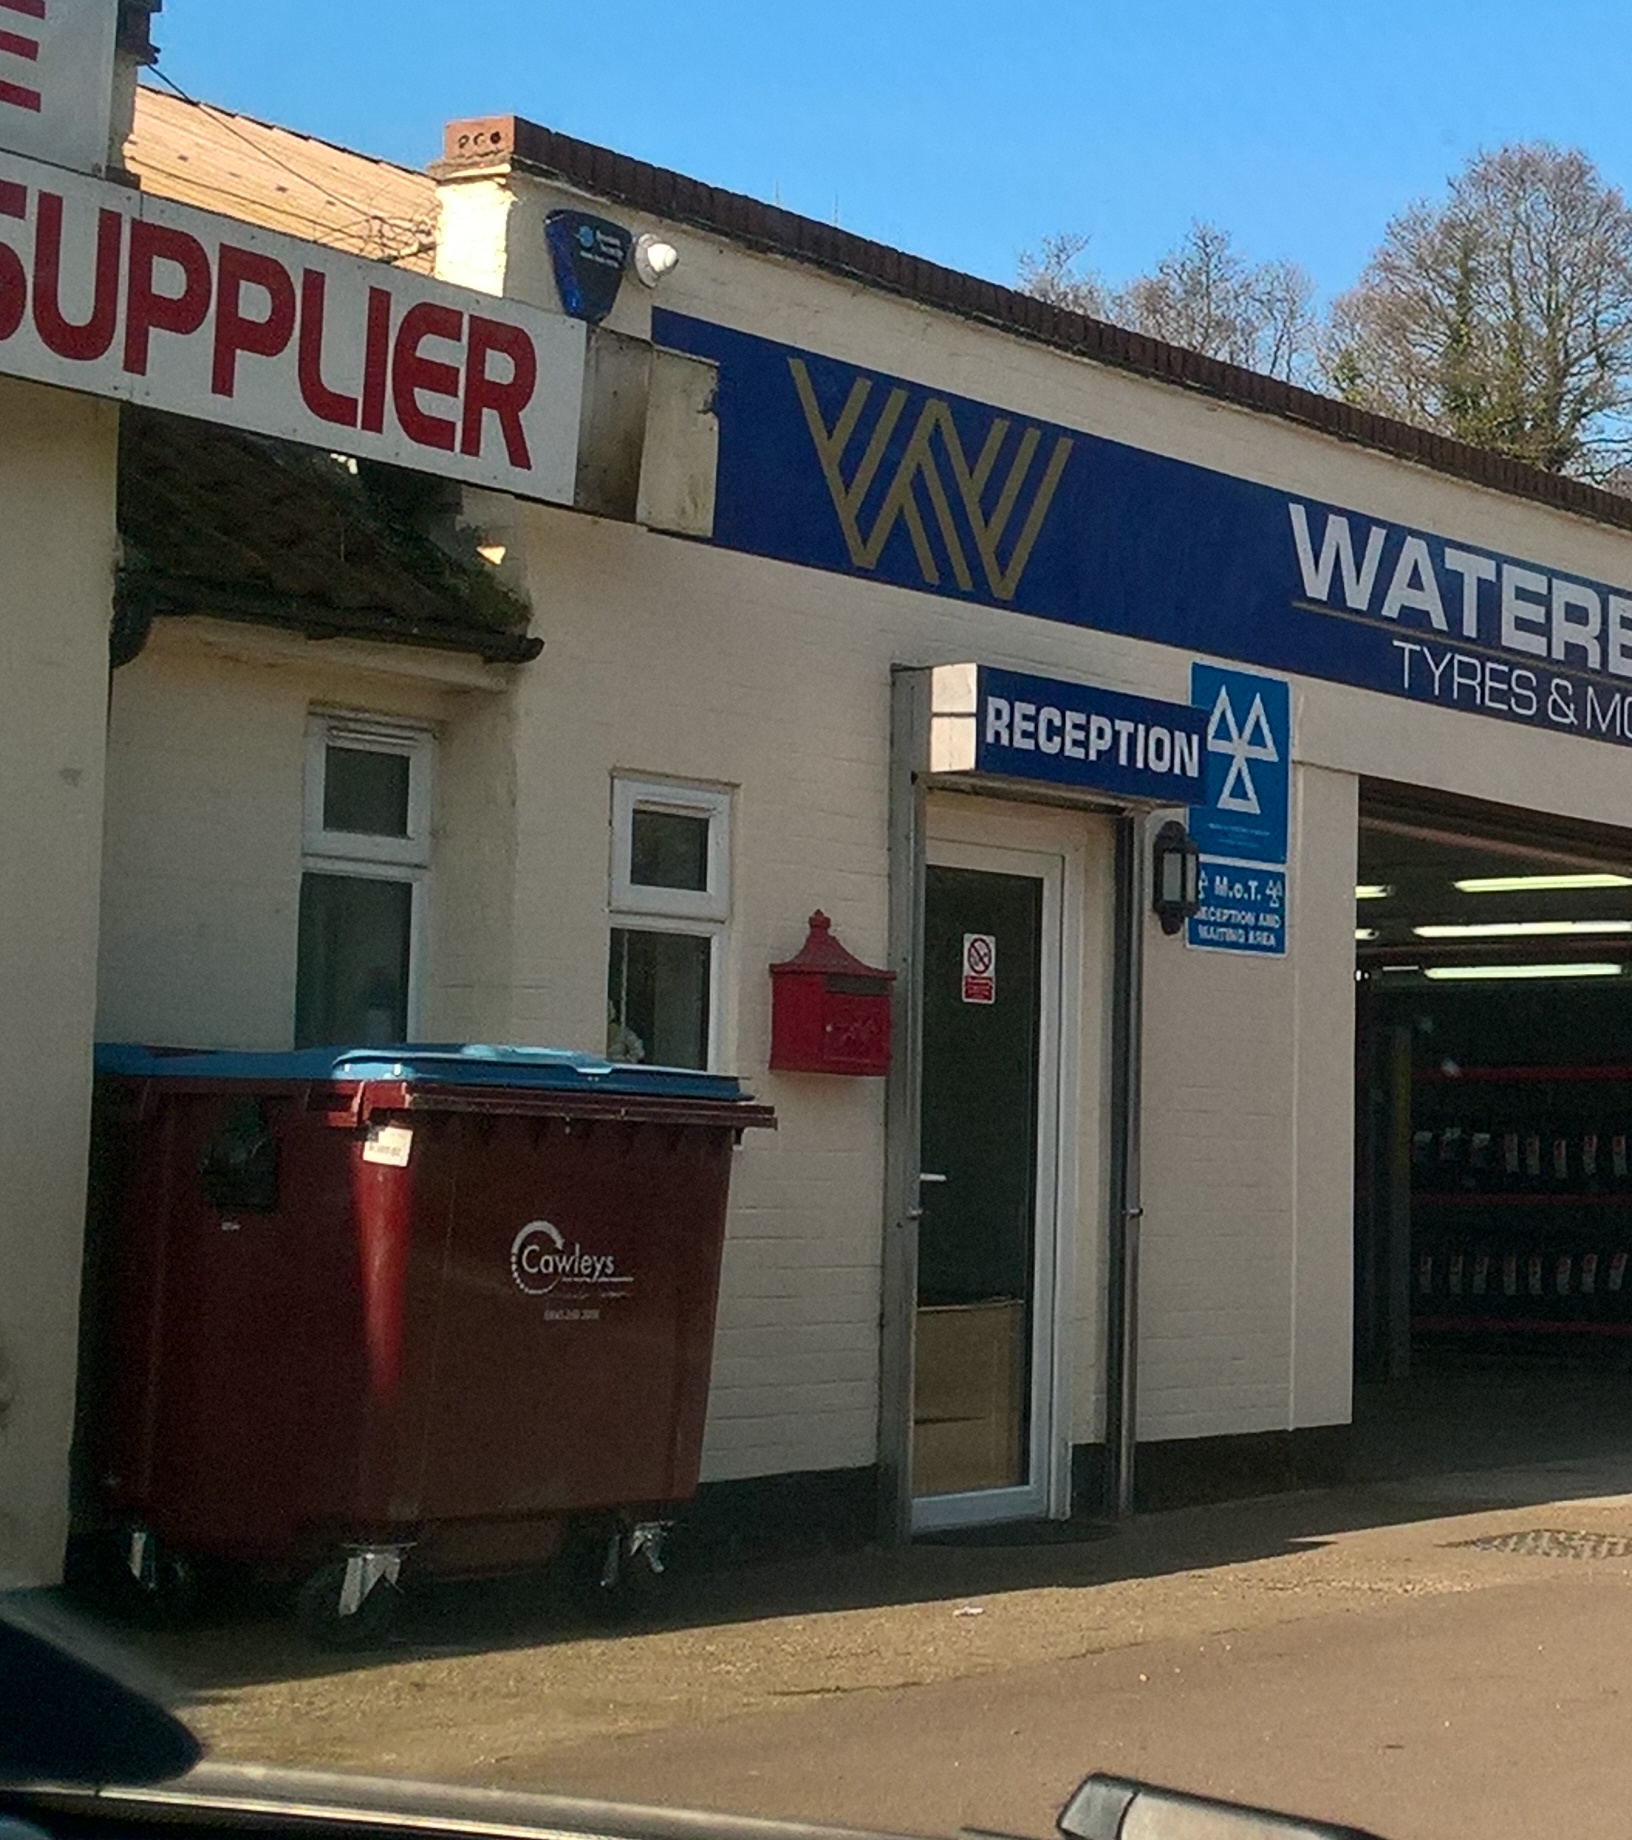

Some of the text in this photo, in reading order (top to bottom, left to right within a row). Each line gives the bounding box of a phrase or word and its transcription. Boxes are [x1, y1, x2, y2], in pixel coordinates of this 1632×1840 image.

[1392, 639, 1538, 717] TYRES
[1547, 678, 1578, 726] &
[985, 695, 1200, 779] RECEPTION
[1214, 875, 1262, 901] M.o.T.
[1258, 911, 1281, 928] AND
[1247, 927, 1277, 948] AREA
[521, 1242, 615, 1284] Cawleys
